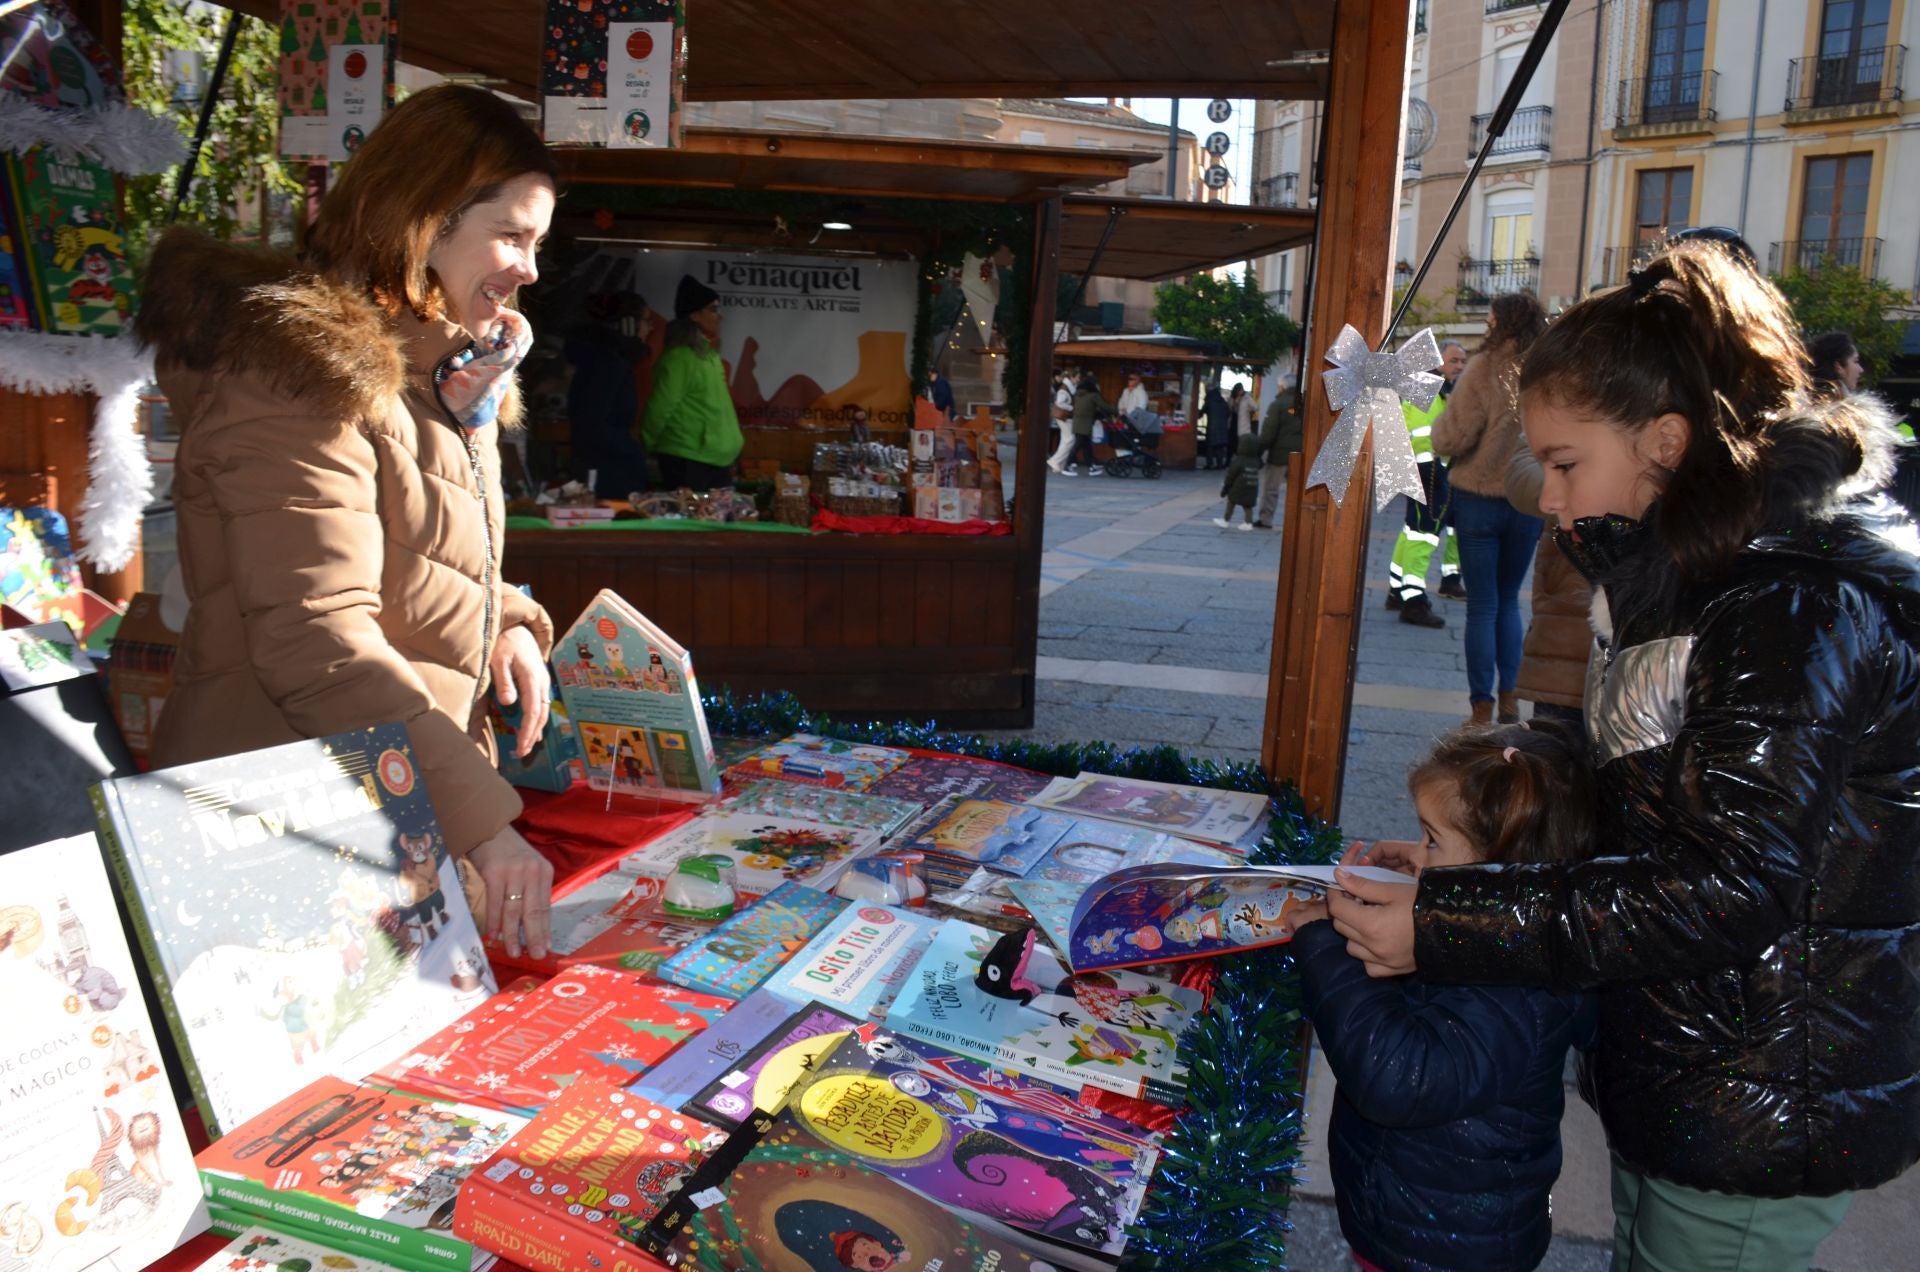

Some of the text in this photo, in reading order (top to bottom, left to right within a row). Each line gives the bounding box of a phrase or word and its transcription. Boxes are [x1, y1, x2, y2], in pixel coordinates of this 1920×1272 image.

[805, 925, 880, 984] Osito Tito
[20, 1032, 80, 1066] COCINA
[514, 1039, 564, 1073] MISTERIO
[561, 1028, 578, 1042] EN
[574, 1001, 619, 1031] NAVIDAD
[518, 1111, 587, 1167] CHARLIE
[597, 1115, 619, 1134] DE
[575, 1127, 646, 1185] NAVIDAD
[522, 1241, 569, 1271] DAHL
